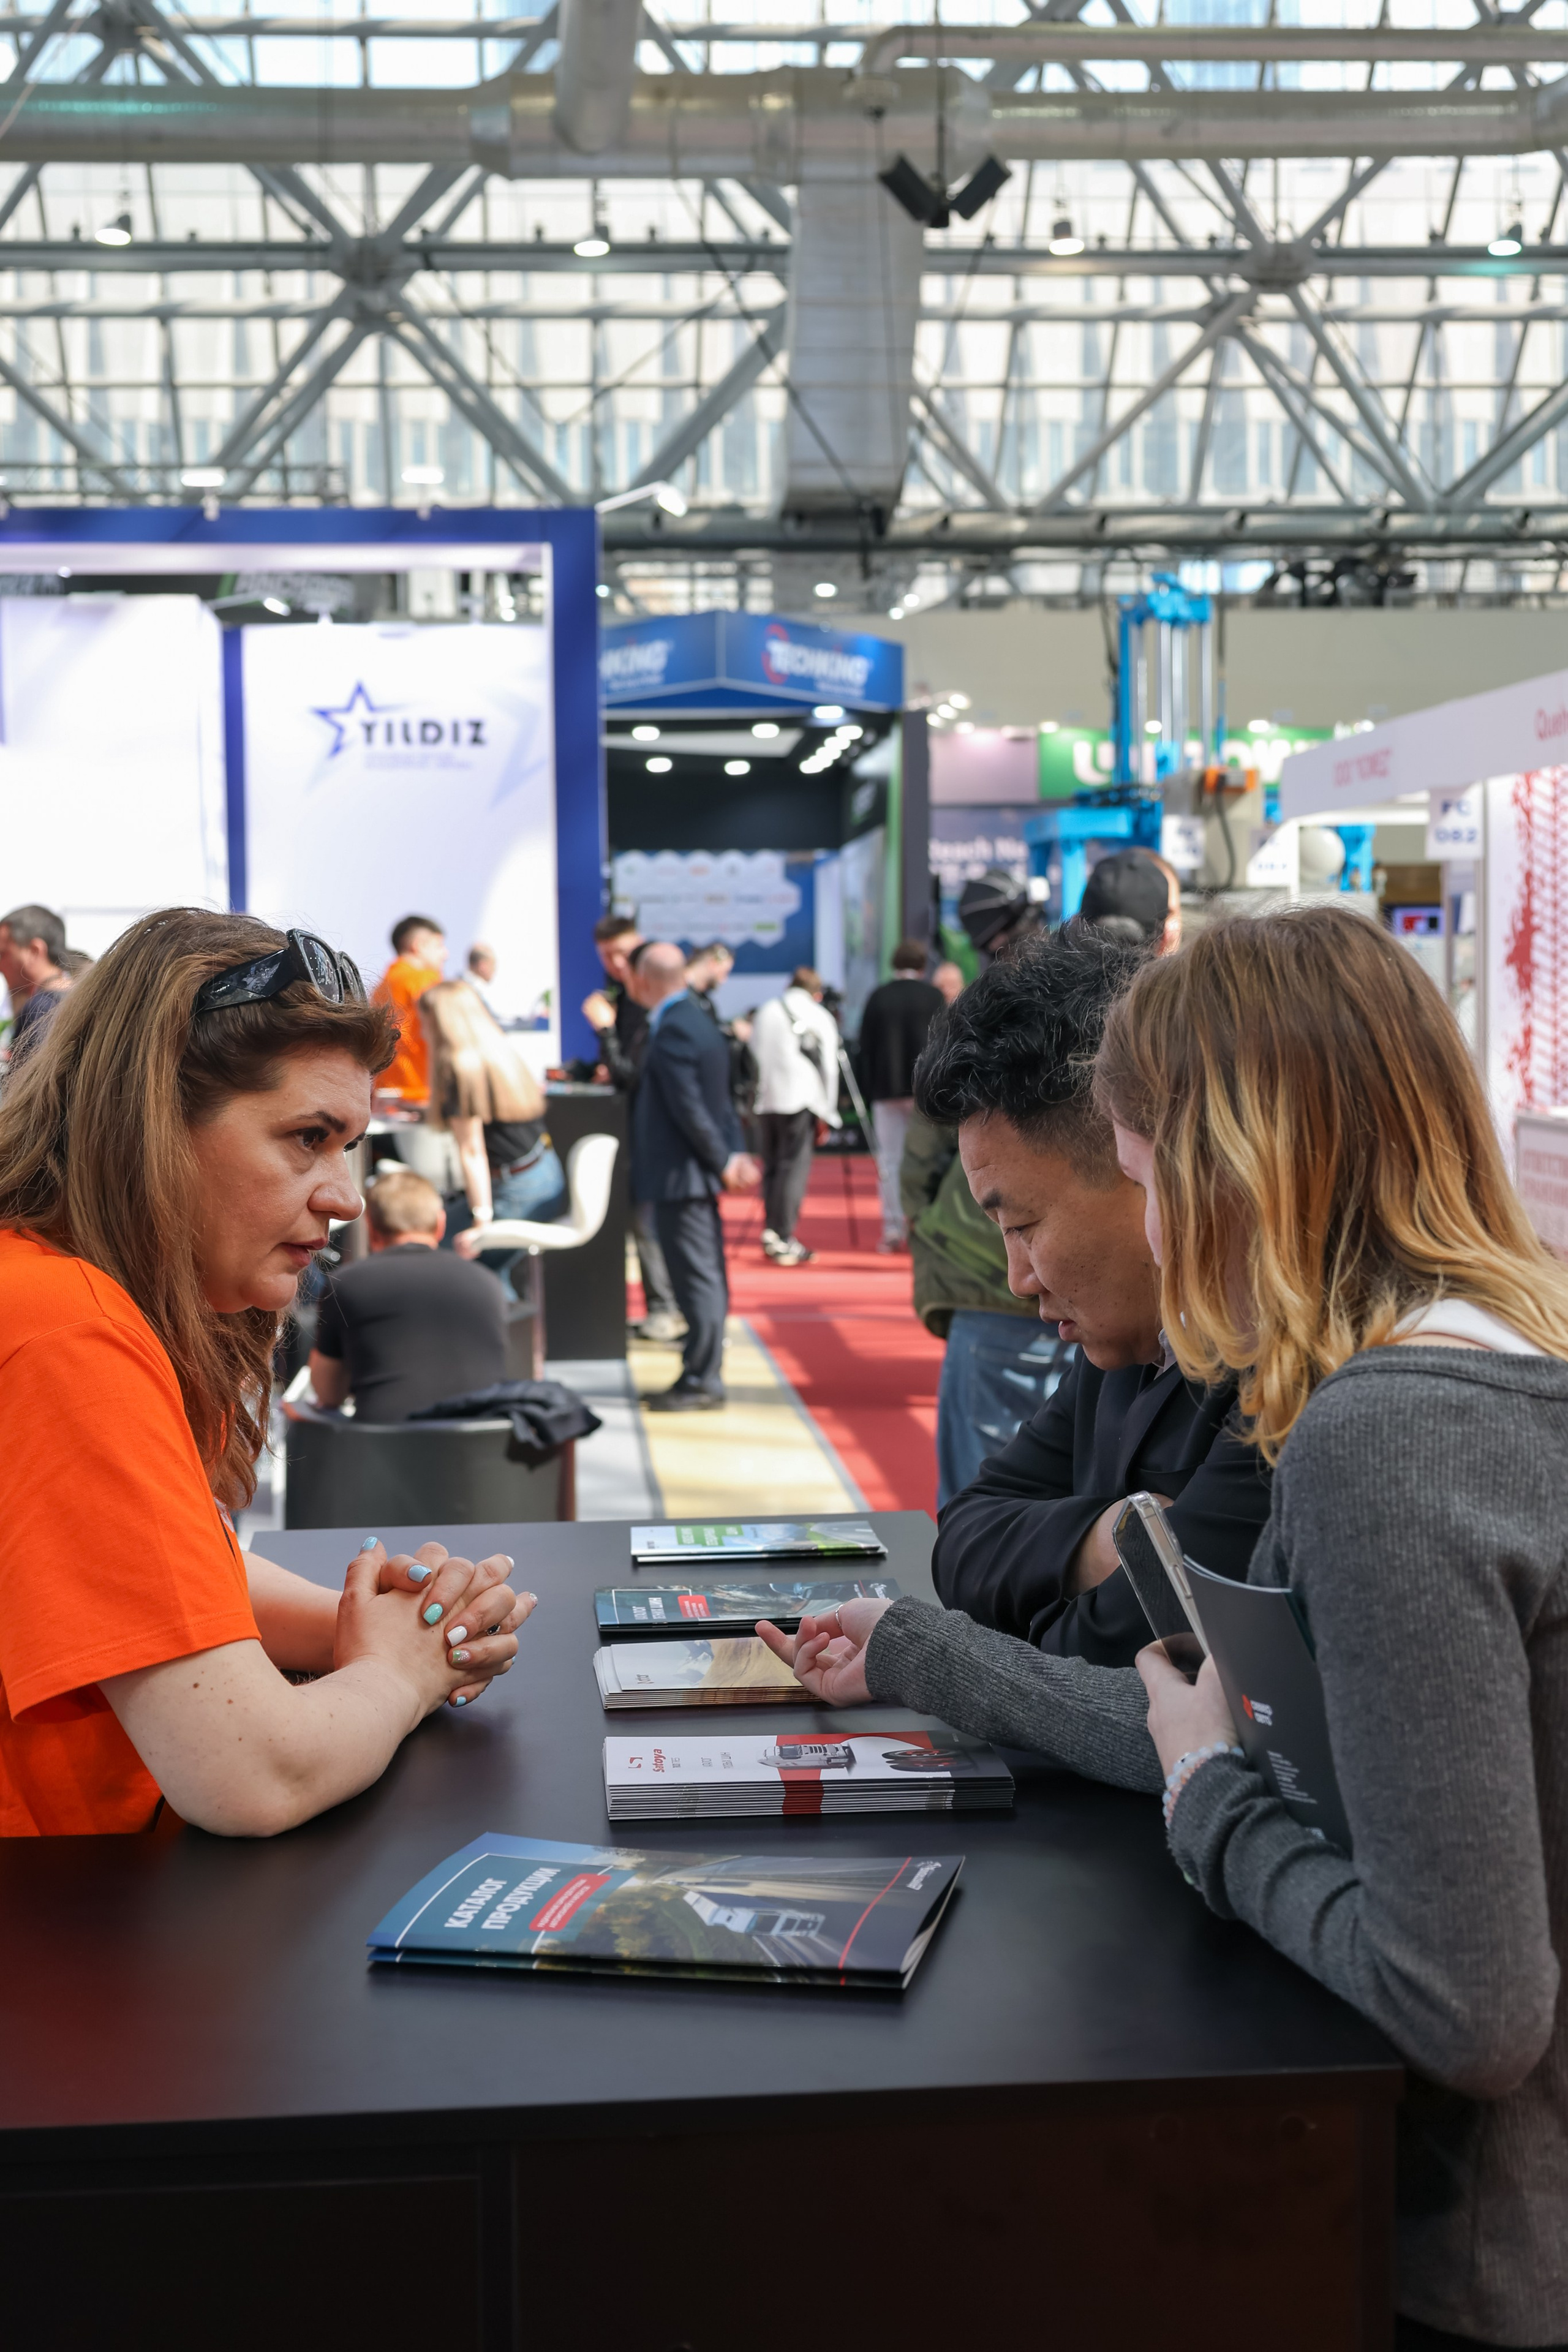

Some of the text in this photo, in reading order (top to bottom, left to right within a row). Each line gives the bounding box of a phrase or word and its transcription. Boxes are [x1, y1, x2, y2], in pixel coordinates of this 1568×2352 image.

[361, 720, 487, 746] YILDIZ
[652, 1748, 666, 1773] Satoya
[444, 1877, 507, 1928] КАТАЛОГ
[481, 1867, 560, 1929] ПРОДУКЦИИ
